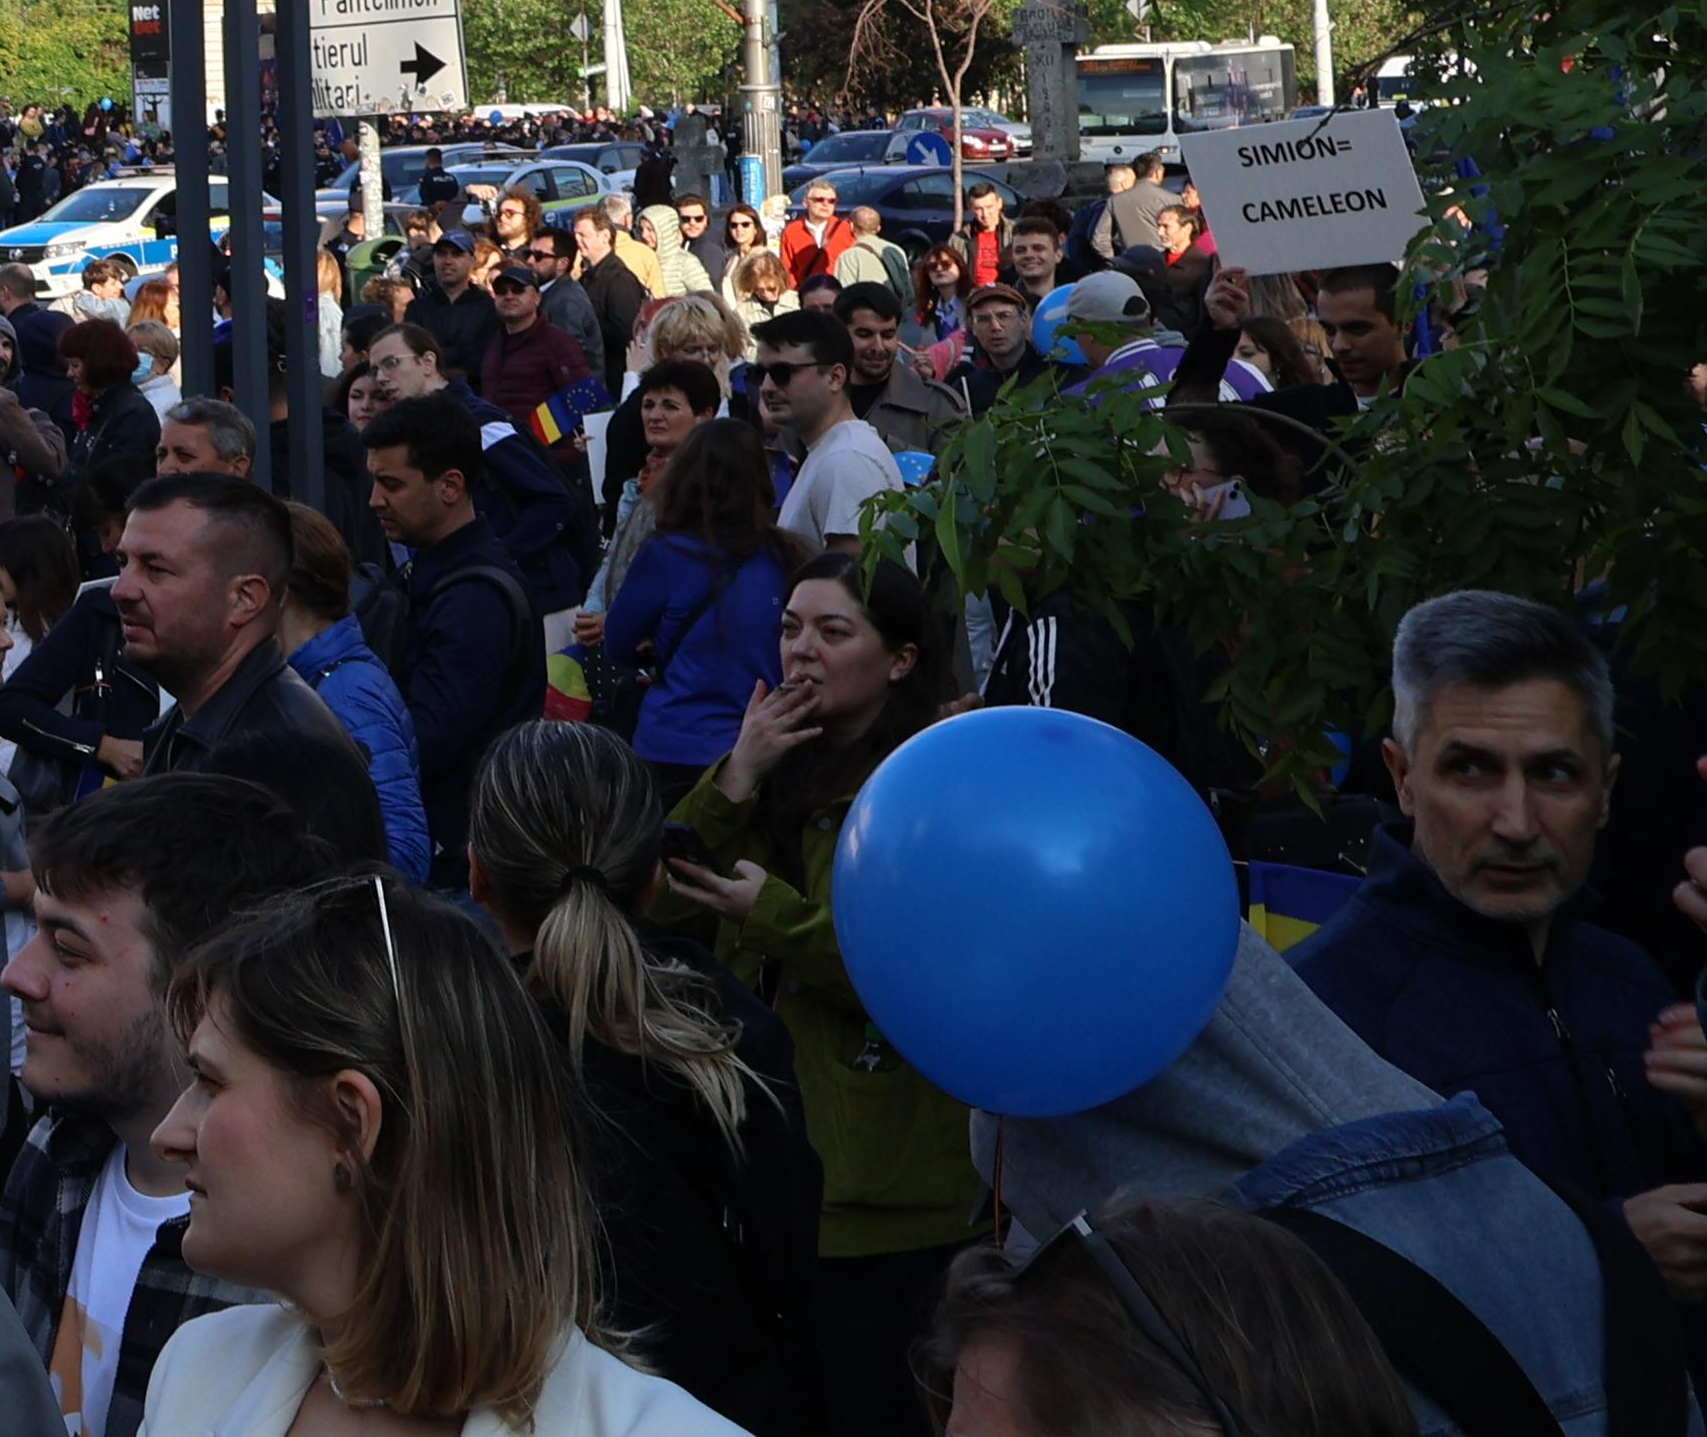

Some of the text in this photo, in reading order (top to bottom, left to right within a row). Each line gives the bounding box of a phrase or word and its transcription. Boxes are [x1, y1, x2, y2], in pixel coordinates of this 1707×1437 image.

[132, 5, 160, 22] Net
[313, 32, 368, 70] tierul
[311, 75, 361, 110] ilitari
[1237, 136, 1353, 168] SIMION=
[1242, 188, 1388, 223] CAMELEON
